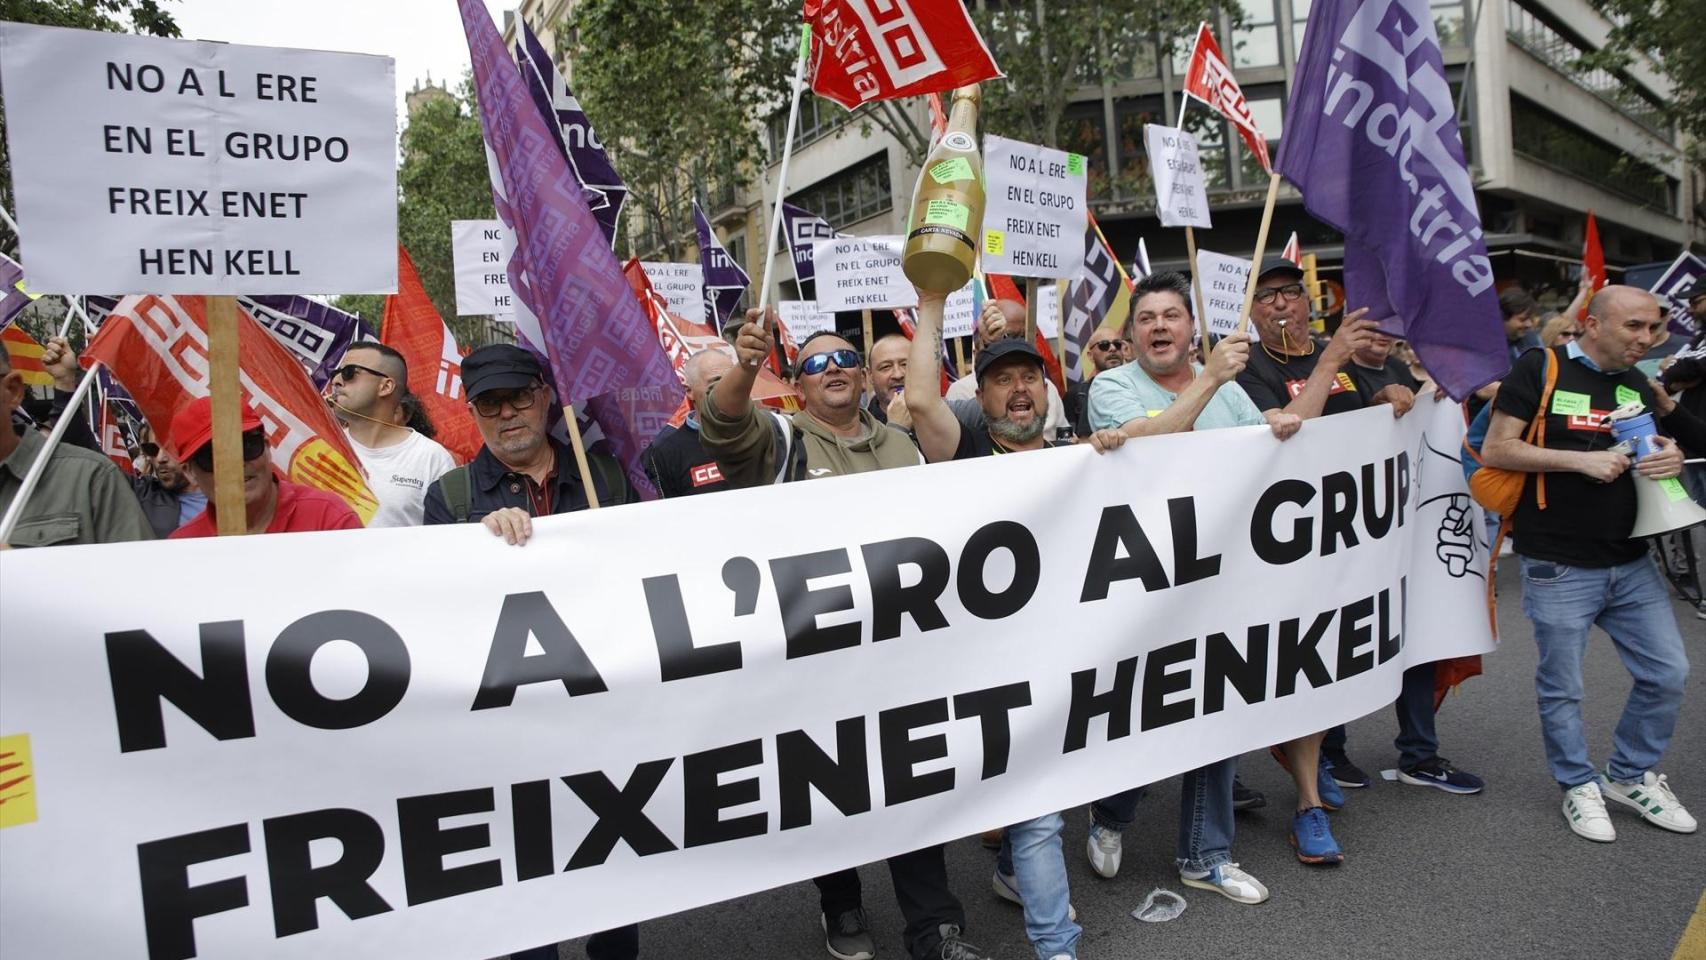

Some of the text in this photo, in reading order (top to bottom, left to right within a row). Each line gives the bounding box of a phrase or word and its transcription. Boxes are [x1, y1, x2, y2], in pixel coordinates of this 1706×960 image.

[106, 62, 318, 103] NO A L ERE
[103, 124, 349, 163] EN EL GRUPO
[1010, 154, 1026, 171] NO
[1028, 159, 1036, 173] A
[1039, 160, 1044, 175] L
[1049, 163, 1066, 179] ERE
[108, 187, 308, 219] FREIX ENET
[1007, 186, 1074, 210] EN EL GRUPO
[1007, 218, 1061, 238] FREIX ENET
[835, 242, 889, 254] NO A L ERE
[140, 248, 300, 276] HEN KELL
[483, 252, 499, 262] EN
[1013, 250, 1058, 268] HEN KELL
[836, 258, 900, 271] EN EL GRUPO
[1218, 263, 1233, 273] NO
[1235, 267, 1241, 275] A
[658, 268, 664, 276] A
[666, 269, 670, 277] L
[675, 269, 688, 277] ERE
[484, 274, 506, 284] FRE
[837, 276, 889, 288] FREIX ENET
[667, 283, 696, 292] GRUPO
[1213, 281, 1225, 290] EN
[1228, 283, 1237, 293] EL
[494, 296, 511, 306] HE
[845, 294, 888, 304] HEN KELL
[1209, 299, 1235, 310] FREIX
[1212, 318, 1231, 329] HEN
[695, 465, 721, 482] CC
[104, 450, 1409, 753] NO A L'ERO AL GRUP
[137, 681, 1032, 960] FREIXENET
